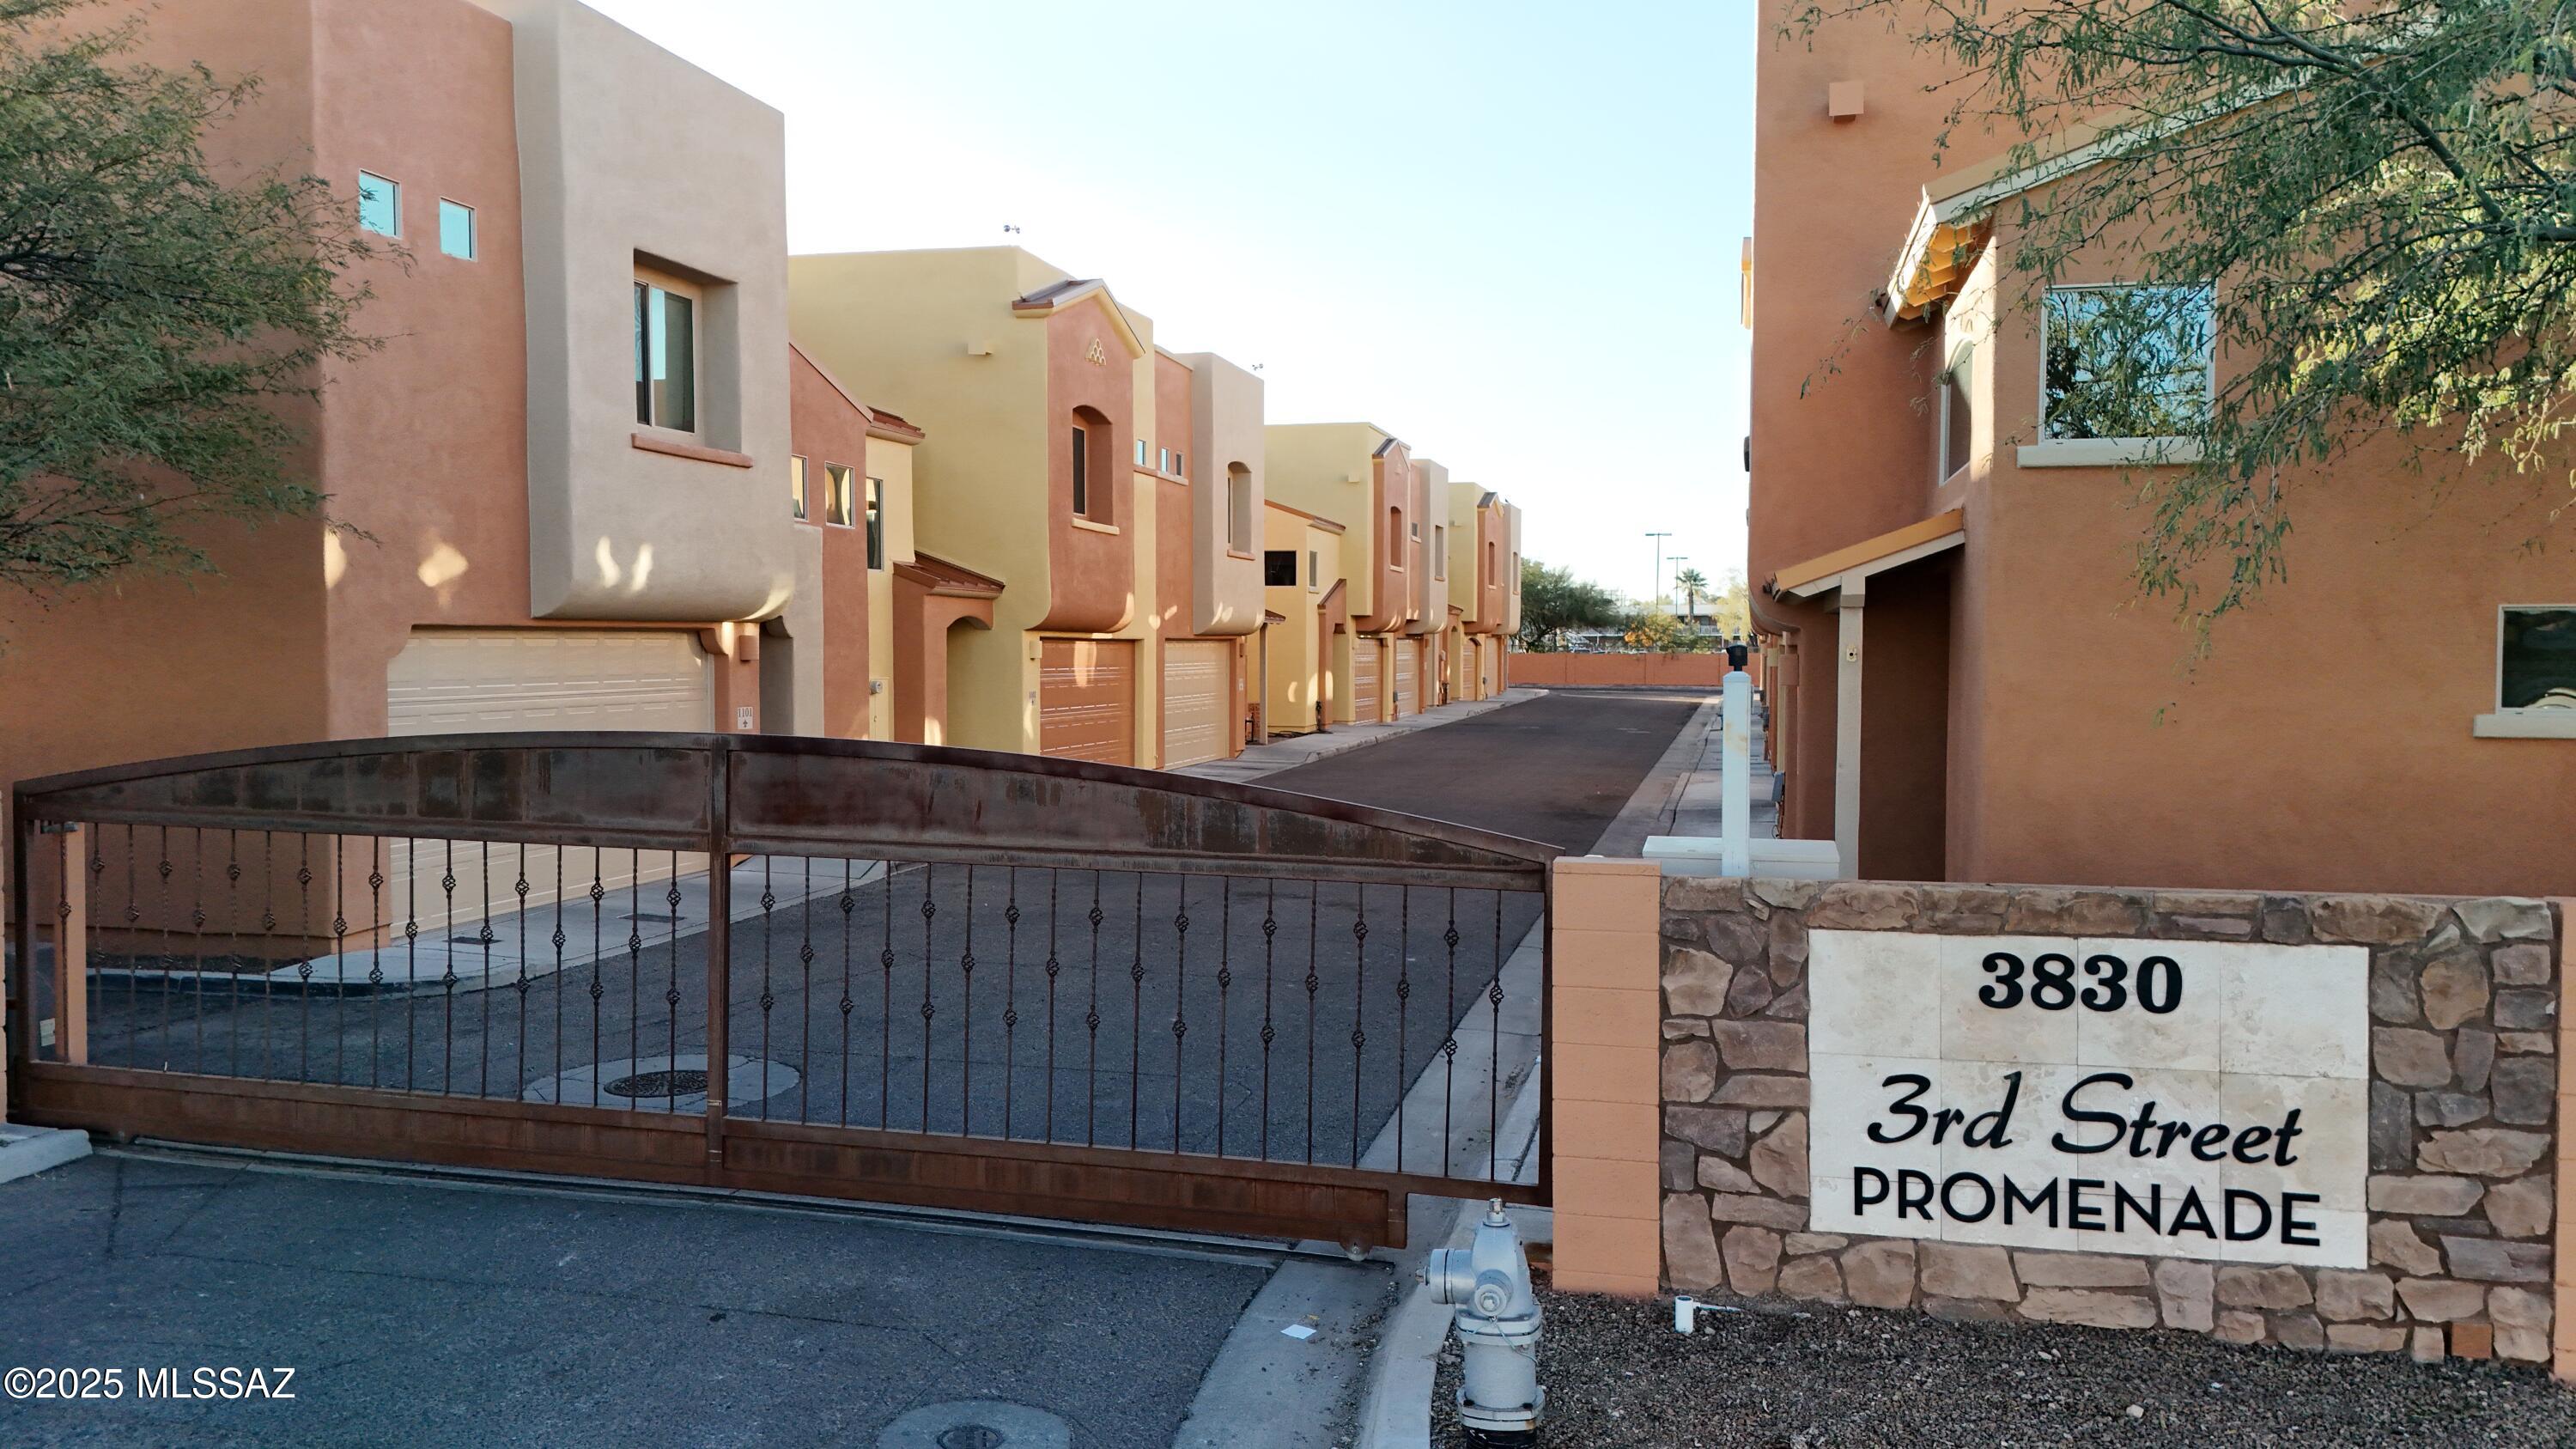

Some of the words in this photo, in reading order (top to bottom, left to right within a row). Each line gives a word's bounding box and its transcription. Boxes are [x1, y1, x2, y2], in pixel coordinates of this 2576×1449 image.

[738, 708, 752, 717] 1101
[1978, 951, 2184, 1015] 3830
[1866, 1070, 2023, 1150] 3rd
[2050, 1072, 2304, 1168] Street
[1853, 1166, 2321, 1247] PROMENADE
